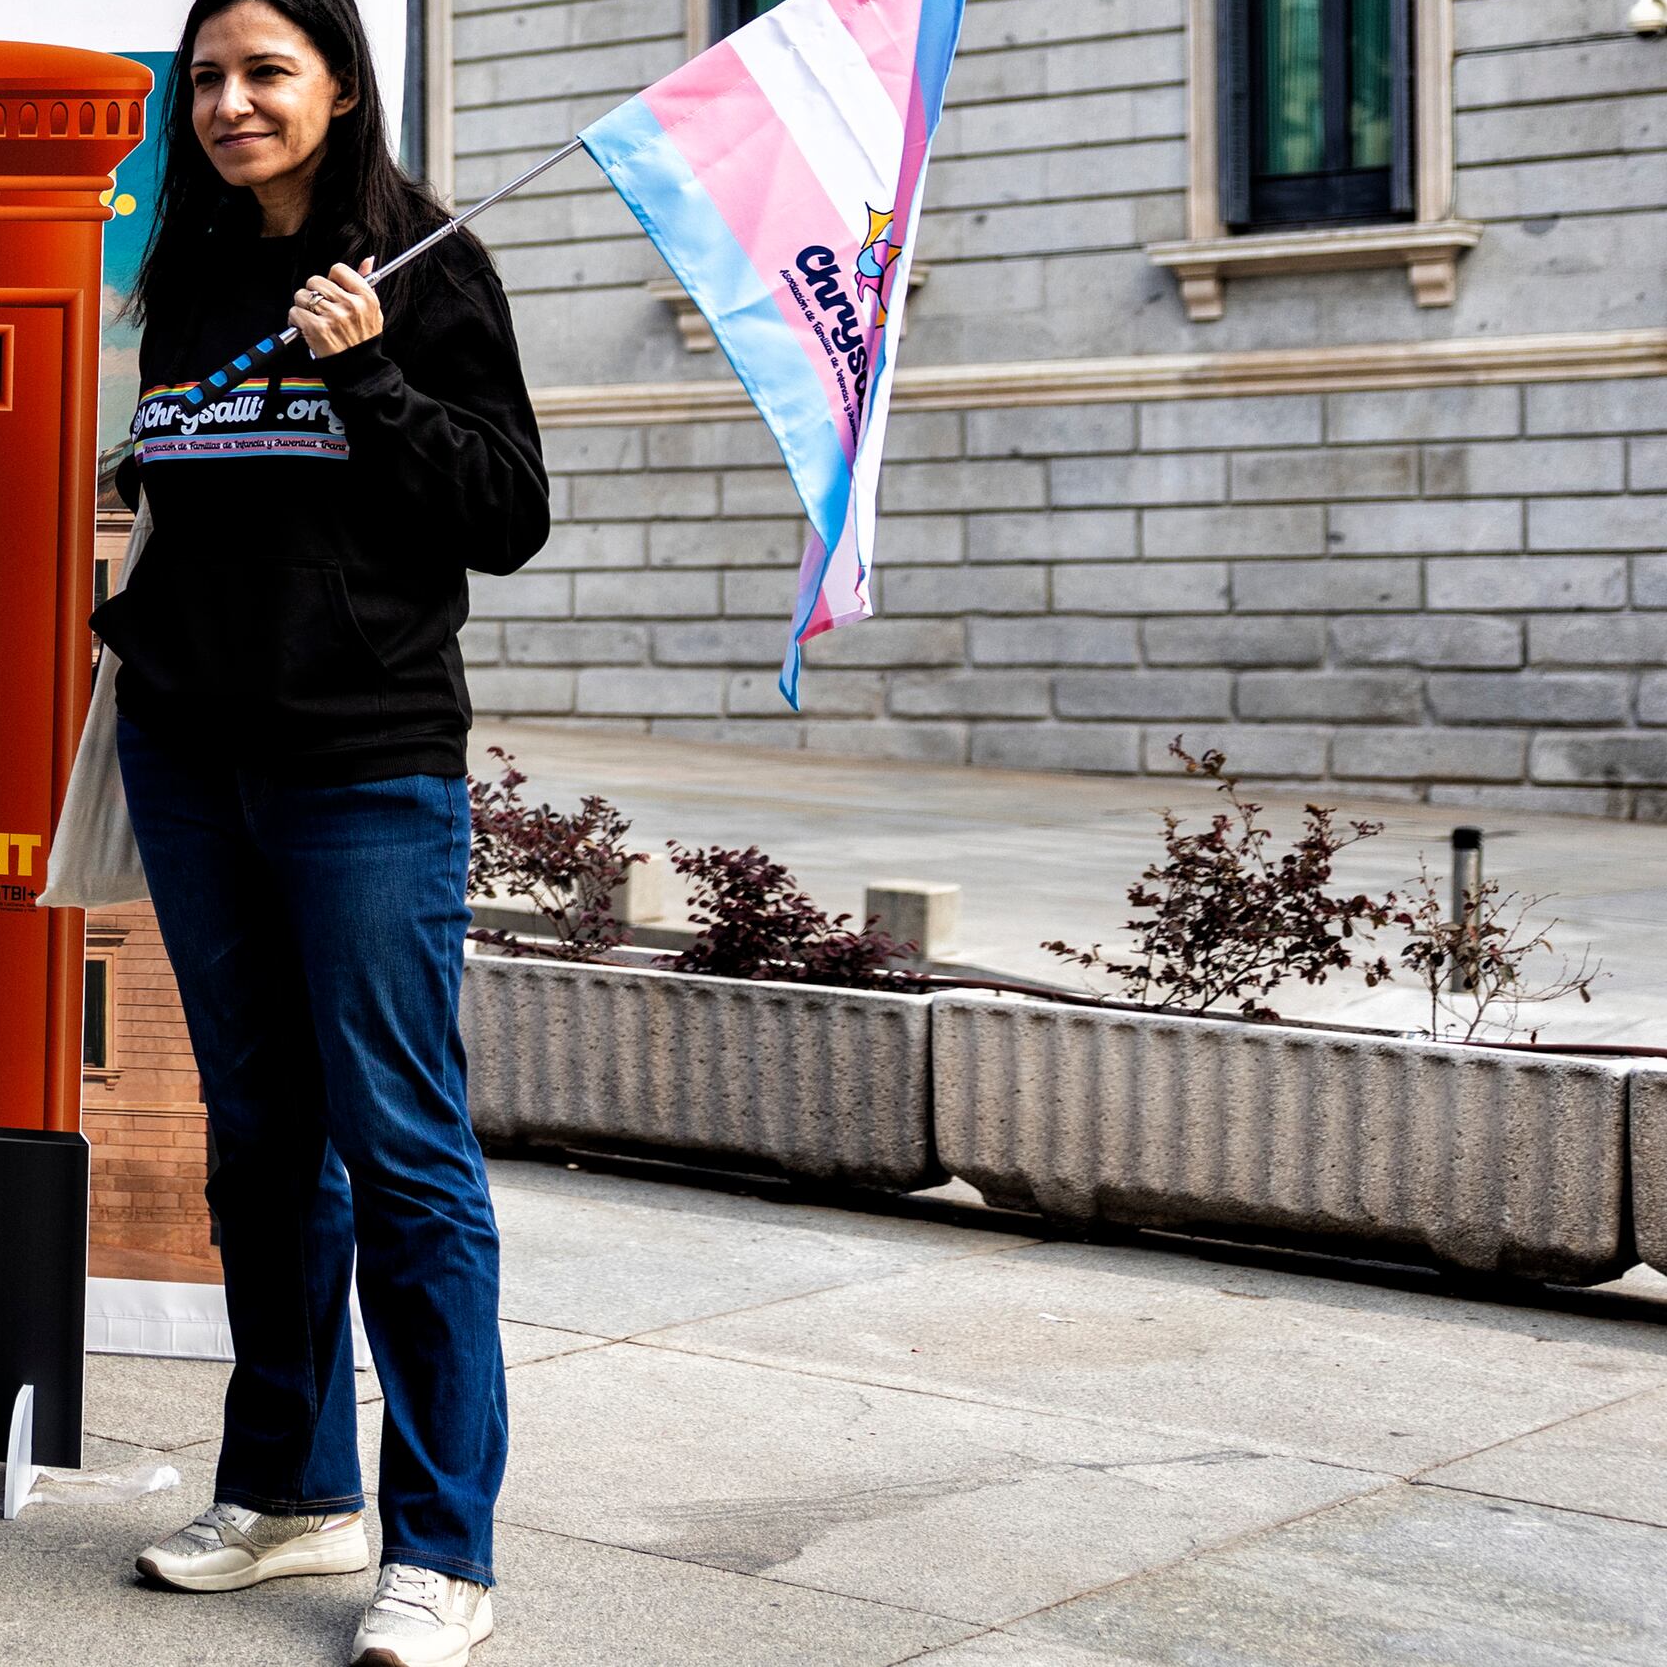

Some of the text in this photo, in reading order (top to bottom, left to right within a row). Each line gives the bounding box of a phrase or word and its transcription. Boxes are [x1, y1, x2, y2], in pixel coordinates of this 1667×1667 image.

[779, 269, 808, 312] Asociación
[805, 309, 816, 323] de
[830, 356, 839, 370] de
[178, 442, 187, 450] de
[222, 441, 233, 450] de
